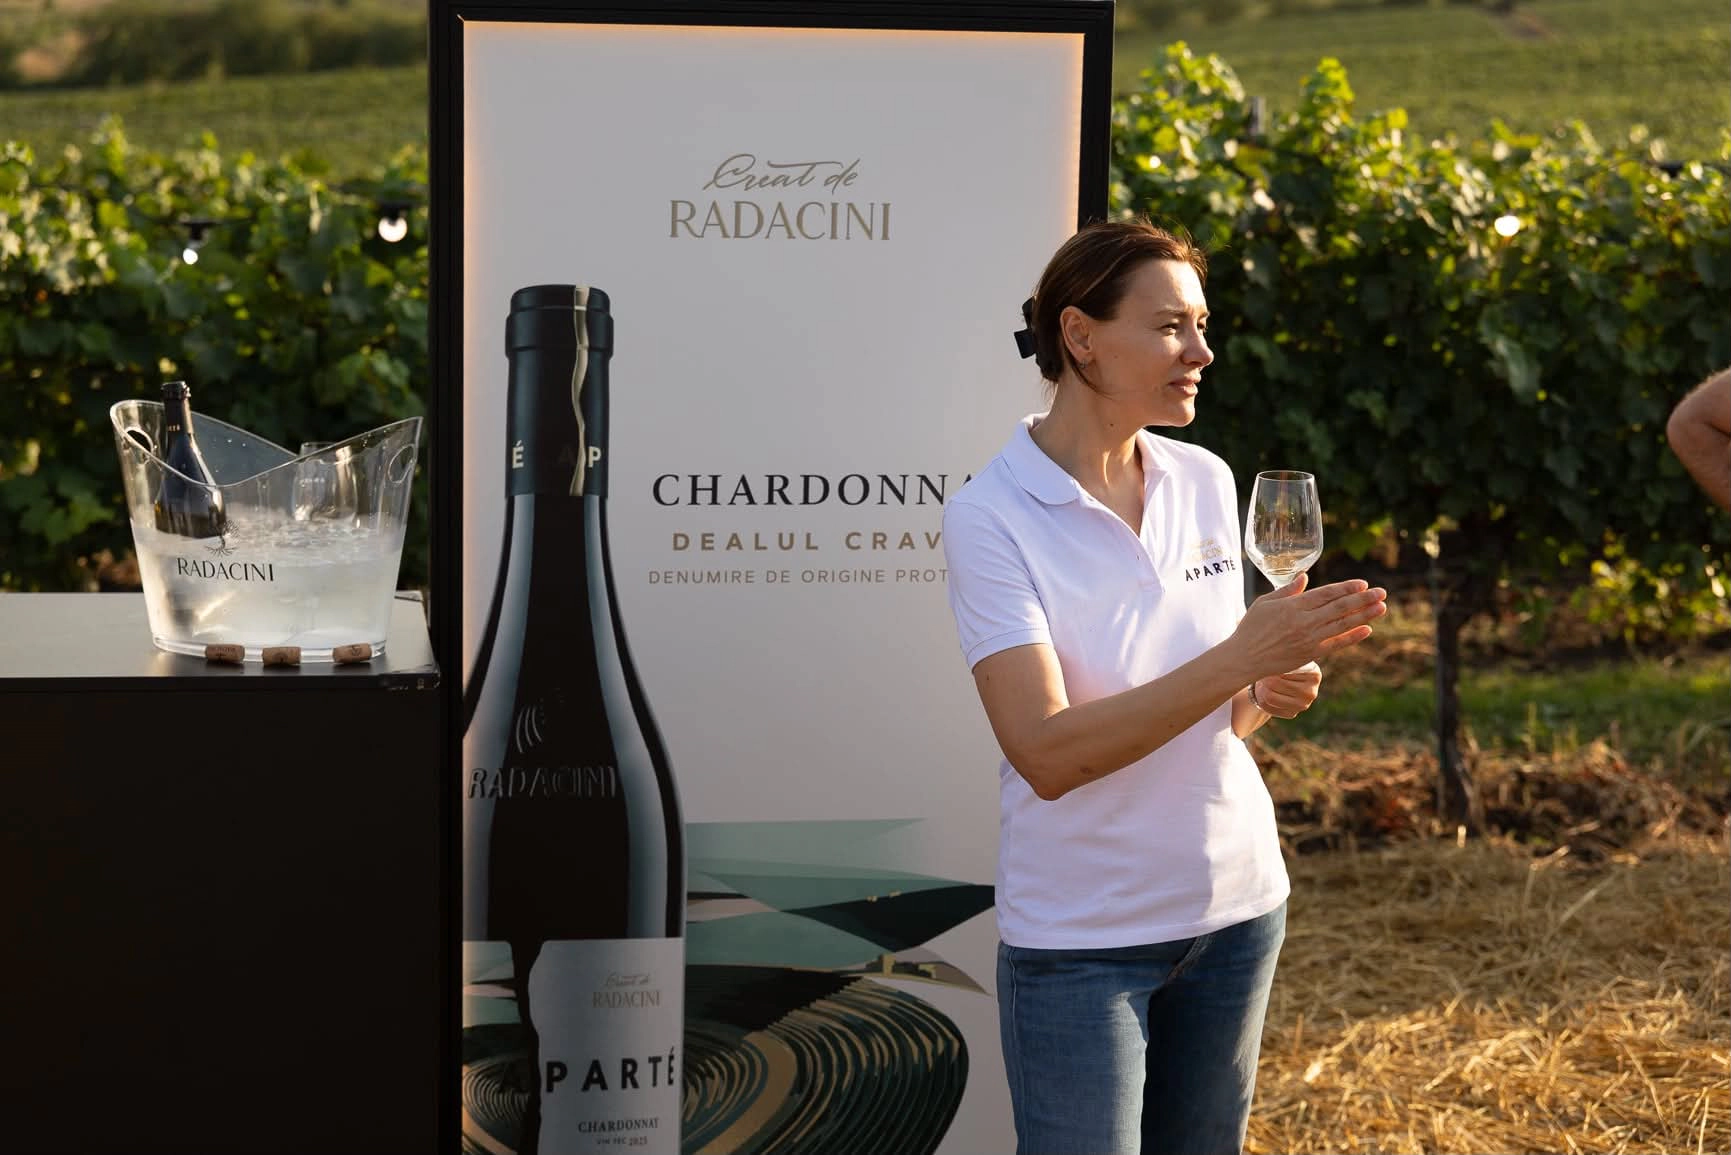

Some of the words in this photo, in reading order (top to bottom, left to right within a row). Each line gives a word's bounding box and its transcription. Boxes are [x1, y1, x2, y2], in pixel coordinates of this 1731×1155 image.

[703, 154, 844, 192] Creat
[824, 158, 861, 196] de
[670, 199, 891, 241] RADACINI
[652, 473, 972, 506] CHARDONN
[672, 531, 820, 551] DEALUL
[845, 531, 942, 550] CRAV
[177, 557, 274, 582] RADACINI
[648, 570, 756, 585] DENUMIRE
[765, 570, 791, 584] DE
[801, 569, 886, 583] ORIGINE
[468, 767, 616, 799] RADACINI
